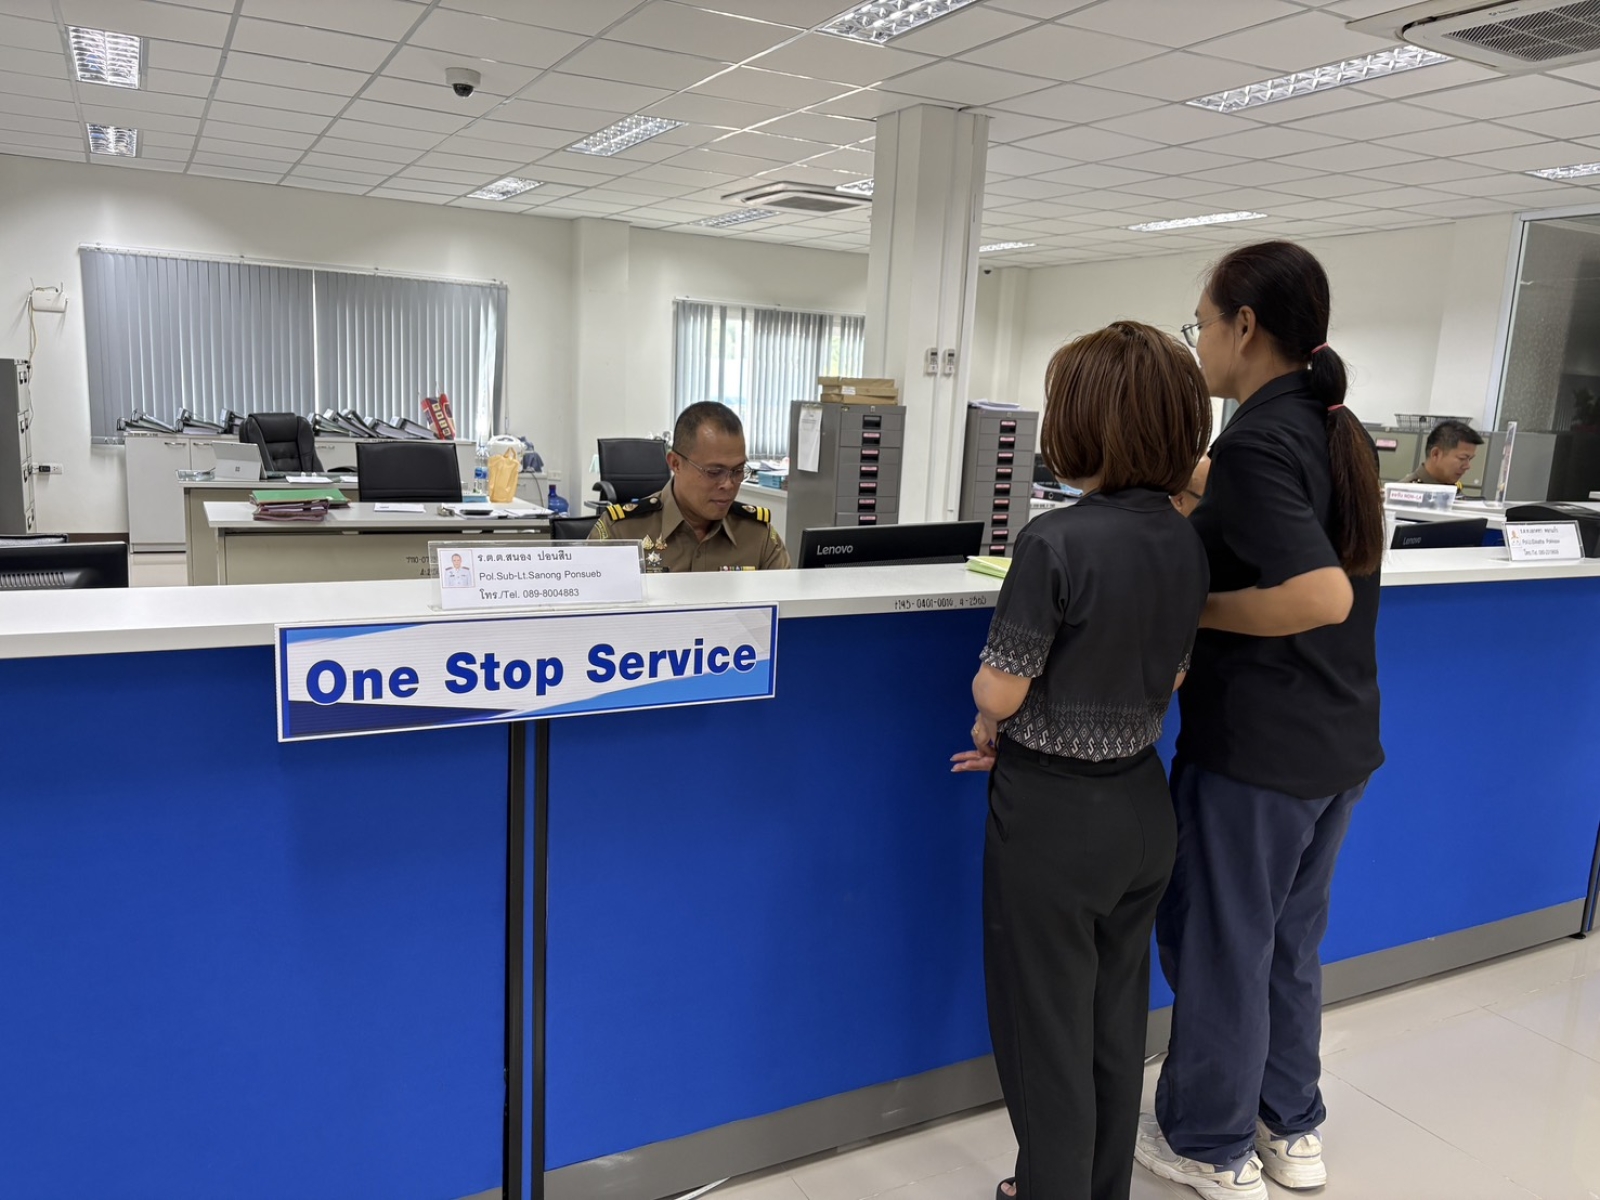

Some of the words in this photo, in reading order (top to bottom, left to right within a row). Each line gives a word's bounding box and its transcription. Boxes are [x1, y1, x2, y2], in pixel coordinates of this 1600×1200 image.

[816, 544, 854, 556] Lenovo
[477, 553, 532, 562] ร.ต.ต.สนอง
[479, 571, 562, 581] Pol.Sub-Lt.Sanong
[564, 569, 602, 579] Ponsueb
[522, 588, 580, 598] 089-8004883
[306, 660, 419, 704] One
[444, 651, 564, 696] Stop
[586, 638, 757, 683] Service
